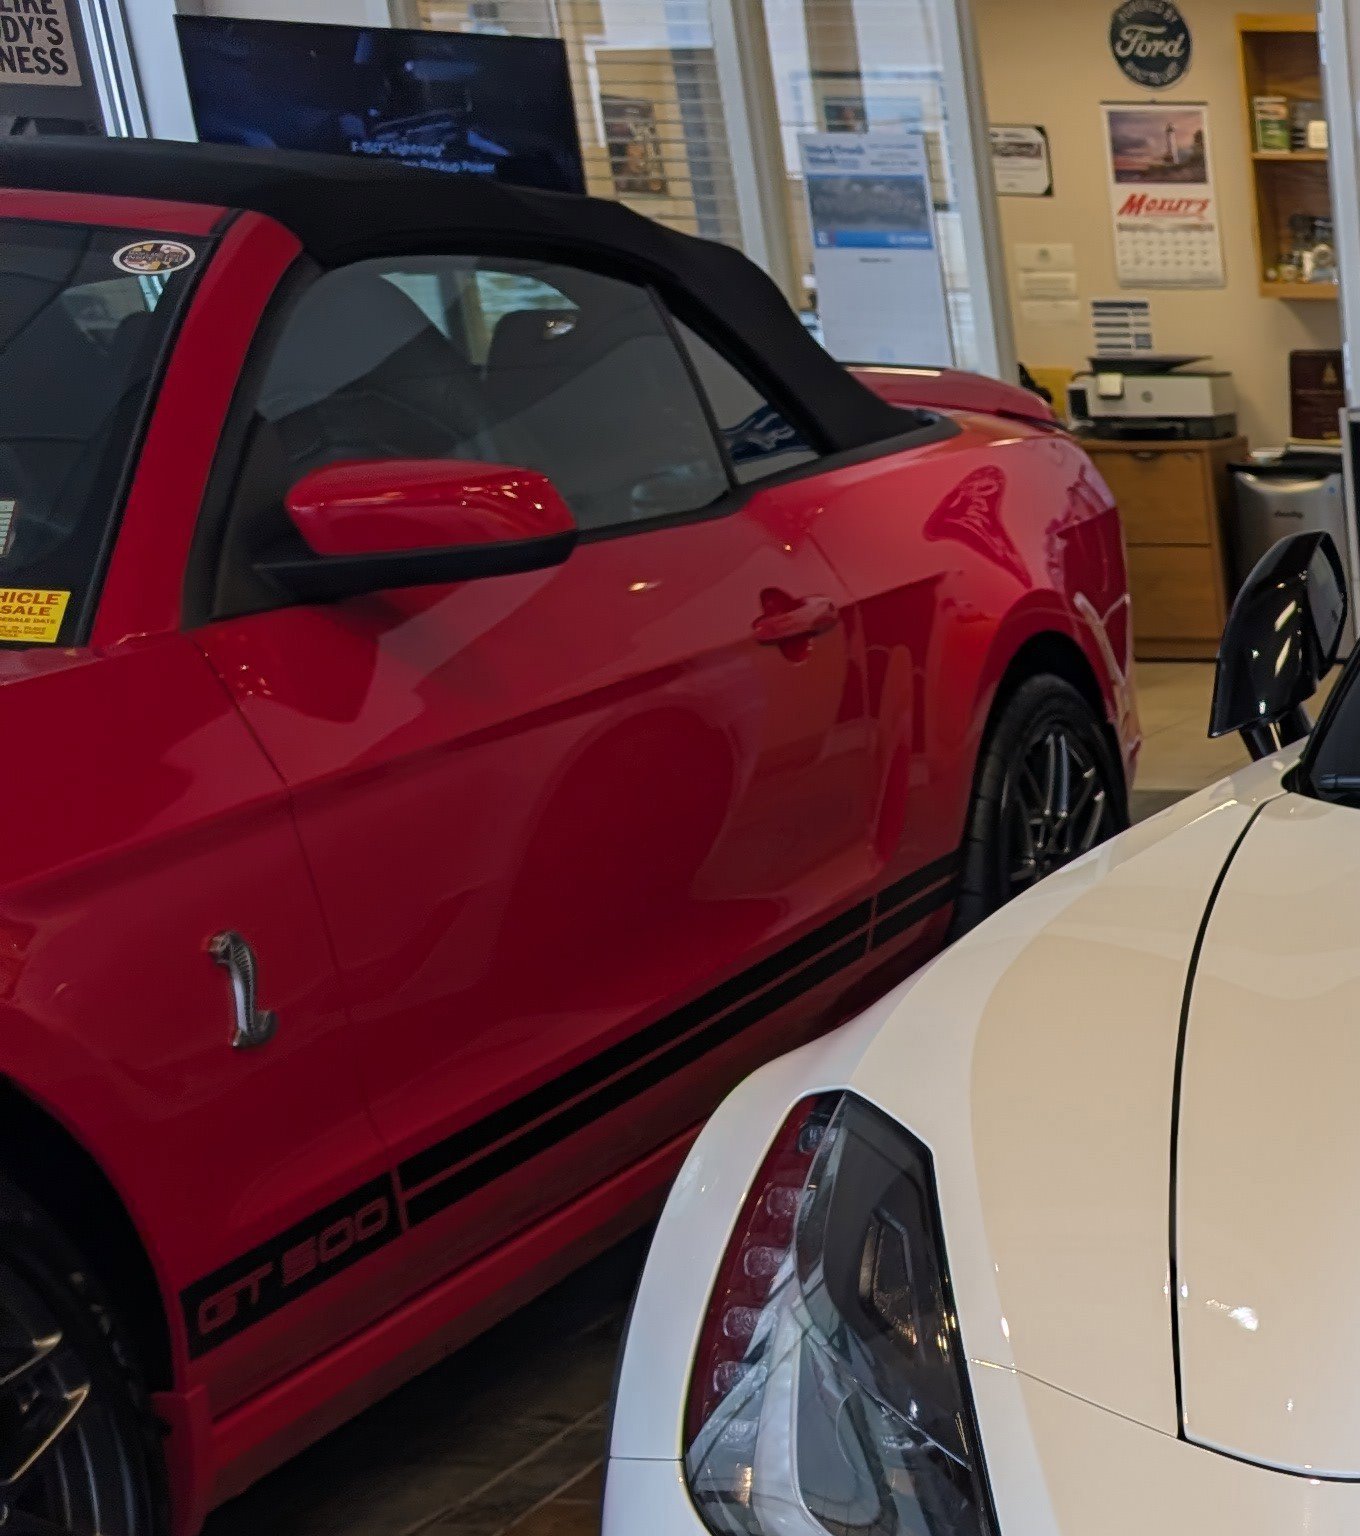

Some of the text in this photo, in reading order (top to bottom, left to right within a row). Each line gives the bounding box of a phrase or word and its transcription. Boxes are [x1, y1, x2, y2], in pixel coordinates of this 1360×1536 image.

[1115, 24, 1185, 57] Ford
[0, 46, 68, 75] NESS
[0, 605, 51, 616] SALE
